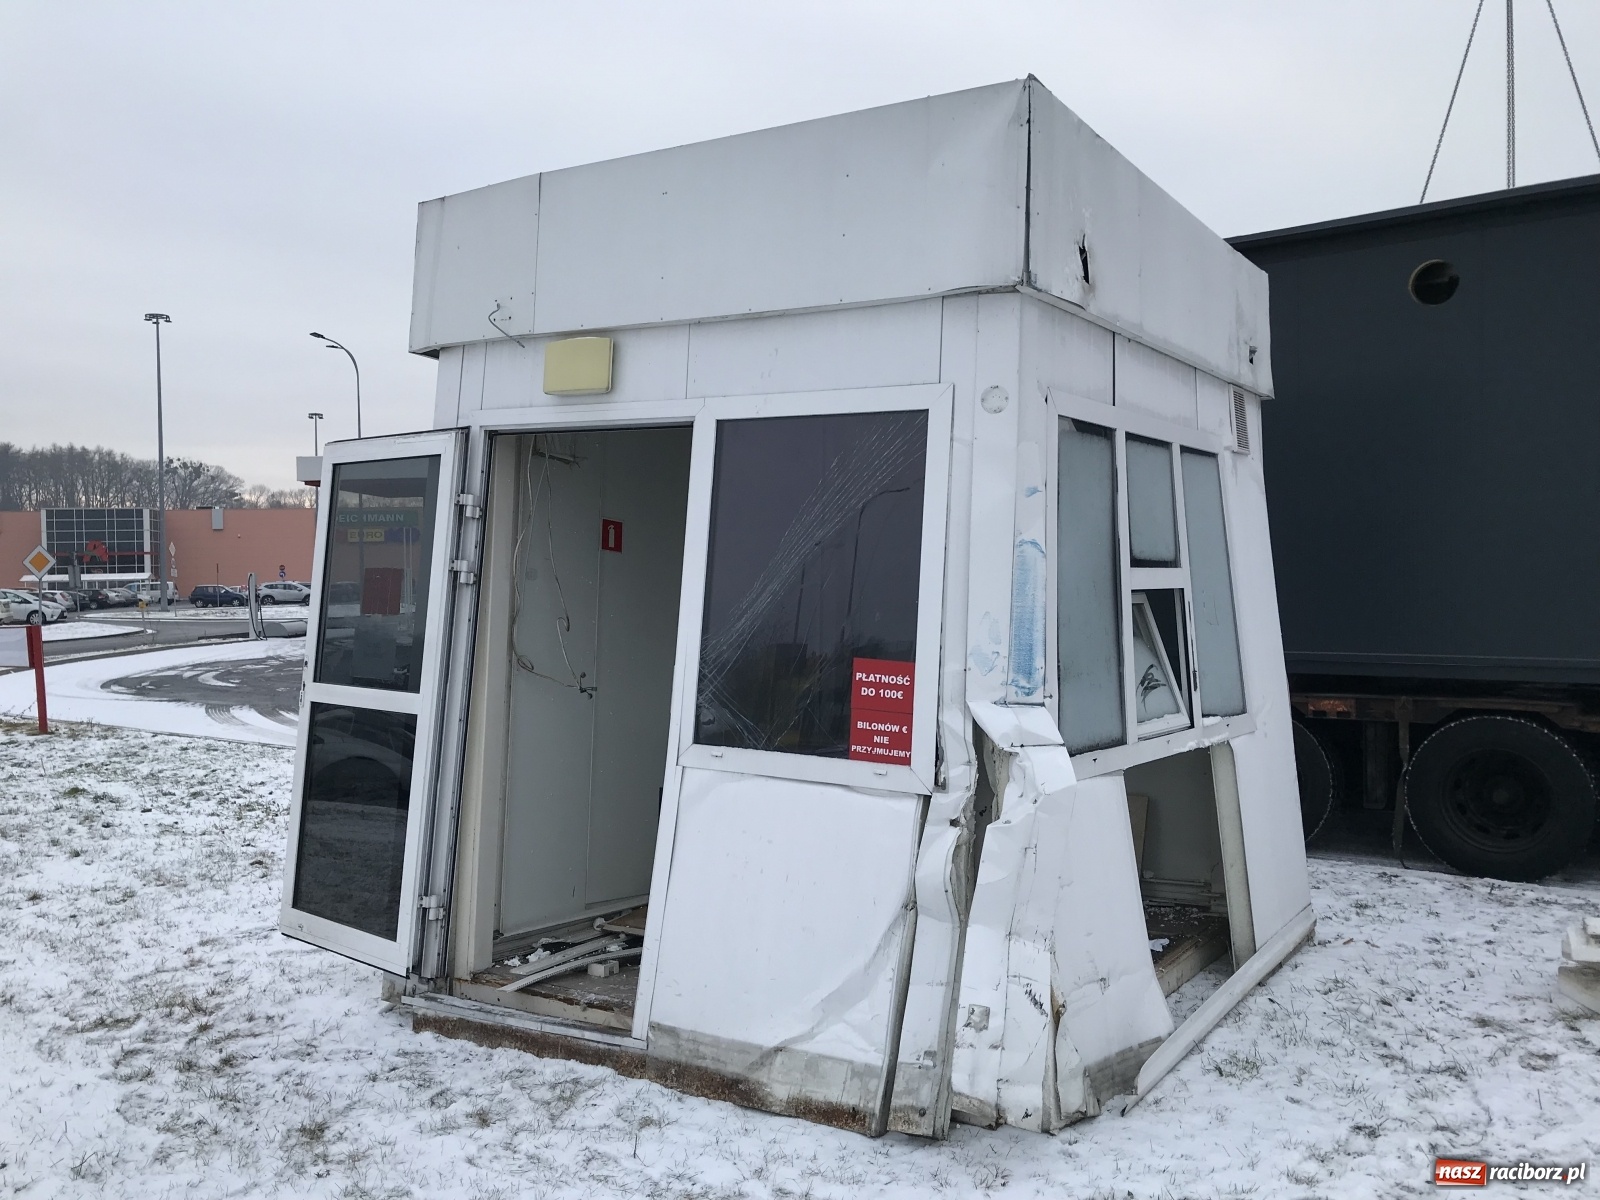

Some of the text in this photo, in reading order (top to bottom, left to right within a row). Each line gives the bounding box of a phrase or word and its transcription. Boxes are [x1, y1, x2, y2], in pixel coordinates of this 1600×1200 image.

[349, 531, 383, 539] ERO
[856, 672, 911, 686] PŁATNOŚĆ
[861, 687, 903, 699] DO 100€
[857, 720, 900, 733] BILONÓW
[873, 735, 889, 744] NIE
[851, 745, 912, 758] PRZYJMUJEMY
